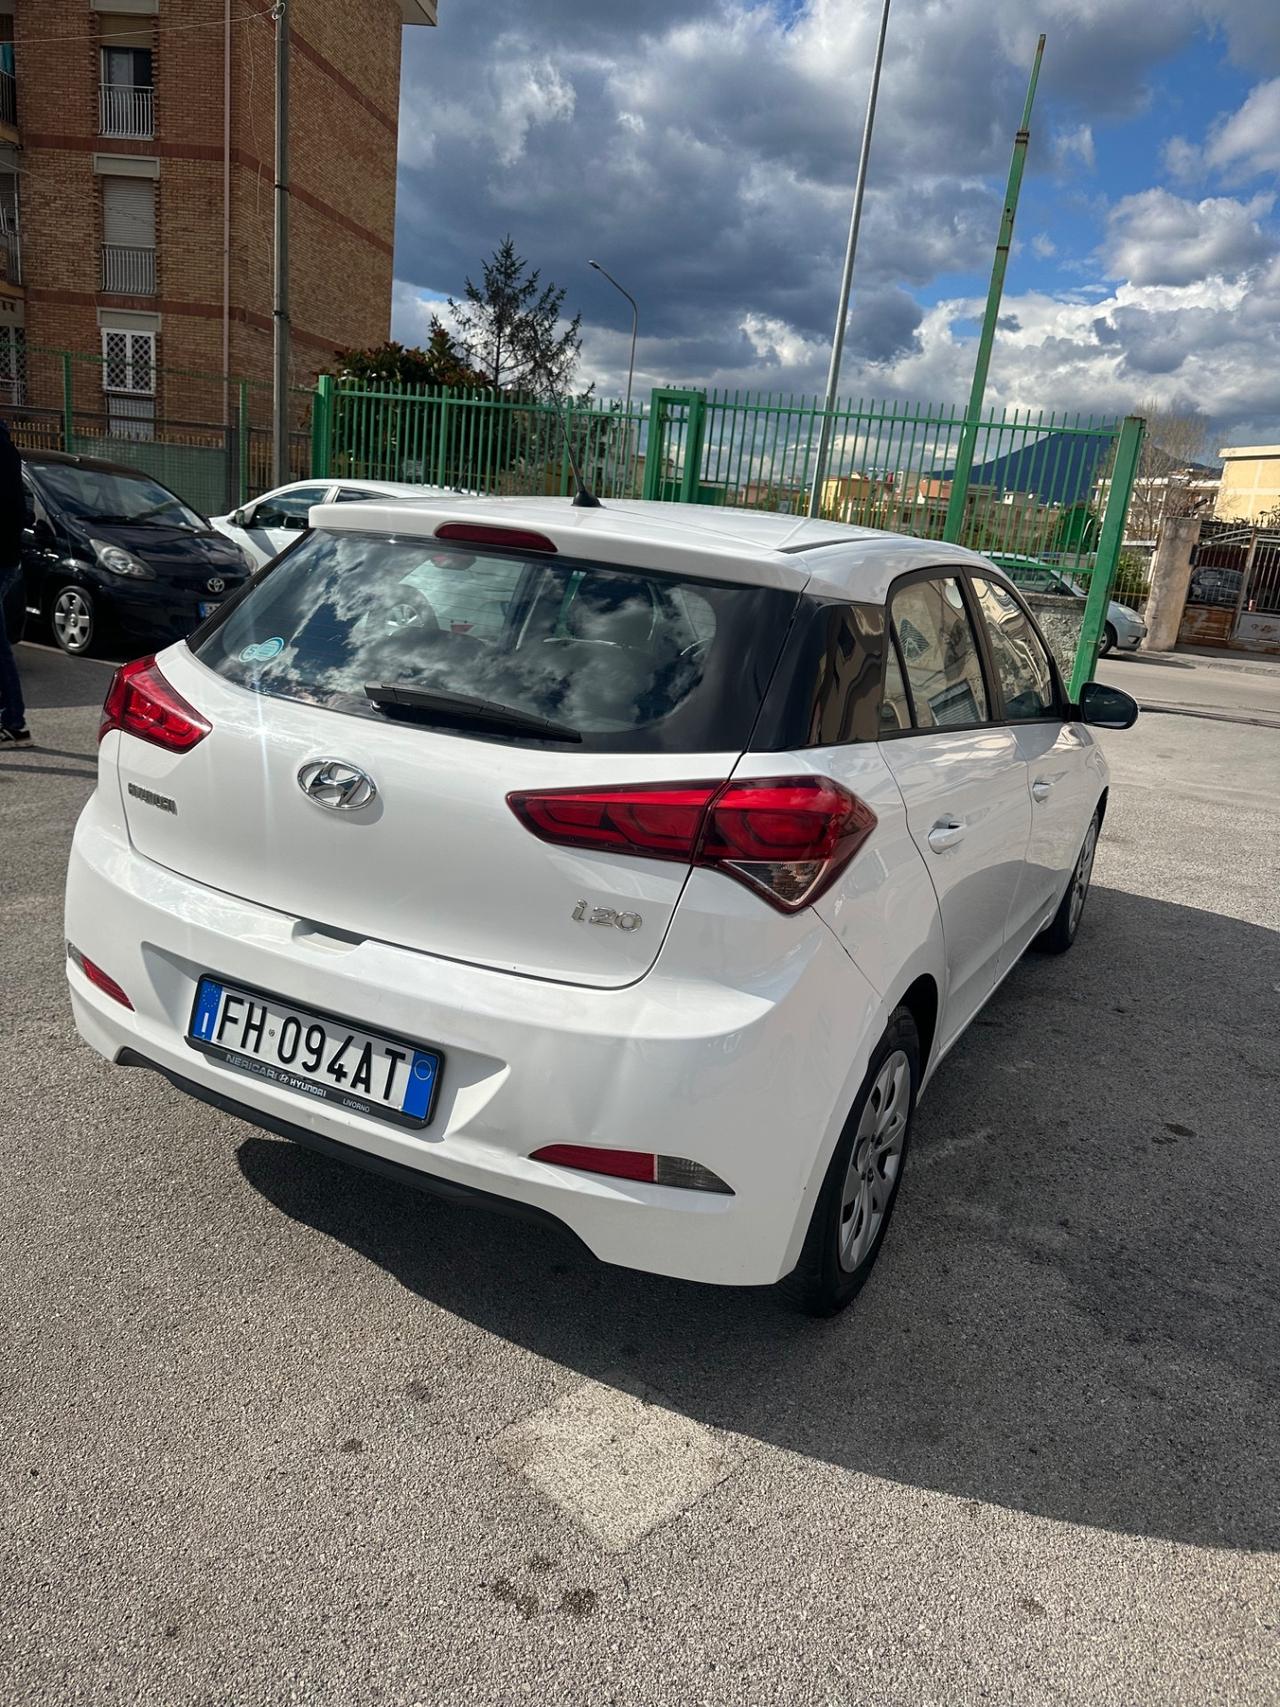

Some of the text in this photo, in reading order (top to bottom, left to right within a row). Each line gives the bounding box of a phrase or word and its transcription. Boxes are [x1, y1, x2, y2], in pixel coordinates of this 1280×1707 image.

[571, 899, 642, 931] i20
[290, 1078, 327, 1097] HYUNDAI
[342, 1098, 370, 1113] LIVORNO
